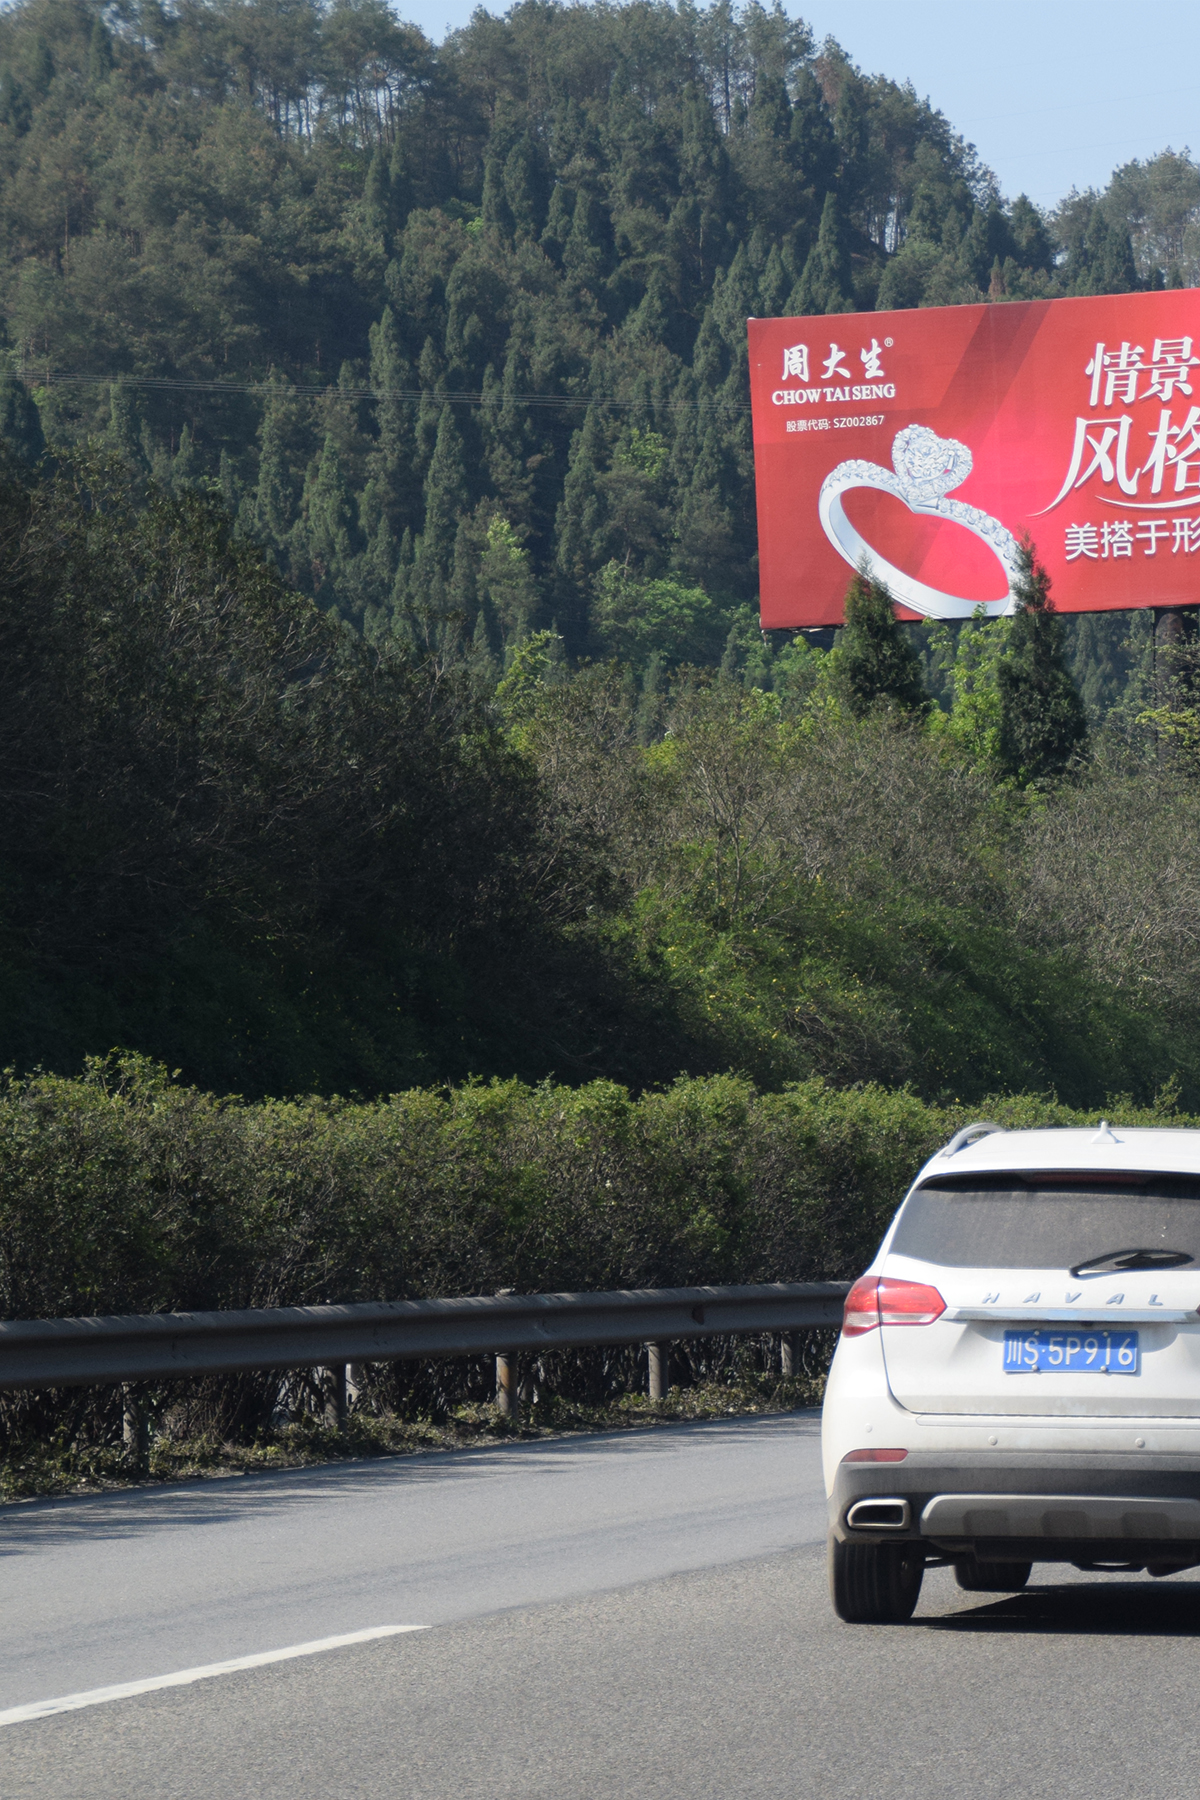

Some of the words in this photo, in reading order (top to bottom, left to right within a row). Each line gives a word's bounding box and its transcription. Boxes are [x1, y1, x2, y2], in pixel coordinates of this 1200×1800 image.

[781, 337, 886, 383] 周大生
[1085, 335, 1200, 407] 情景
[771, 388, 821, 406] CHOW
[822, 386, 851, 402] TAI
[852, 383, 896, 401] SENG
[833, 415, 885, 430] SZ002867
[981, 1291, 1164, 1307] HAVAL
